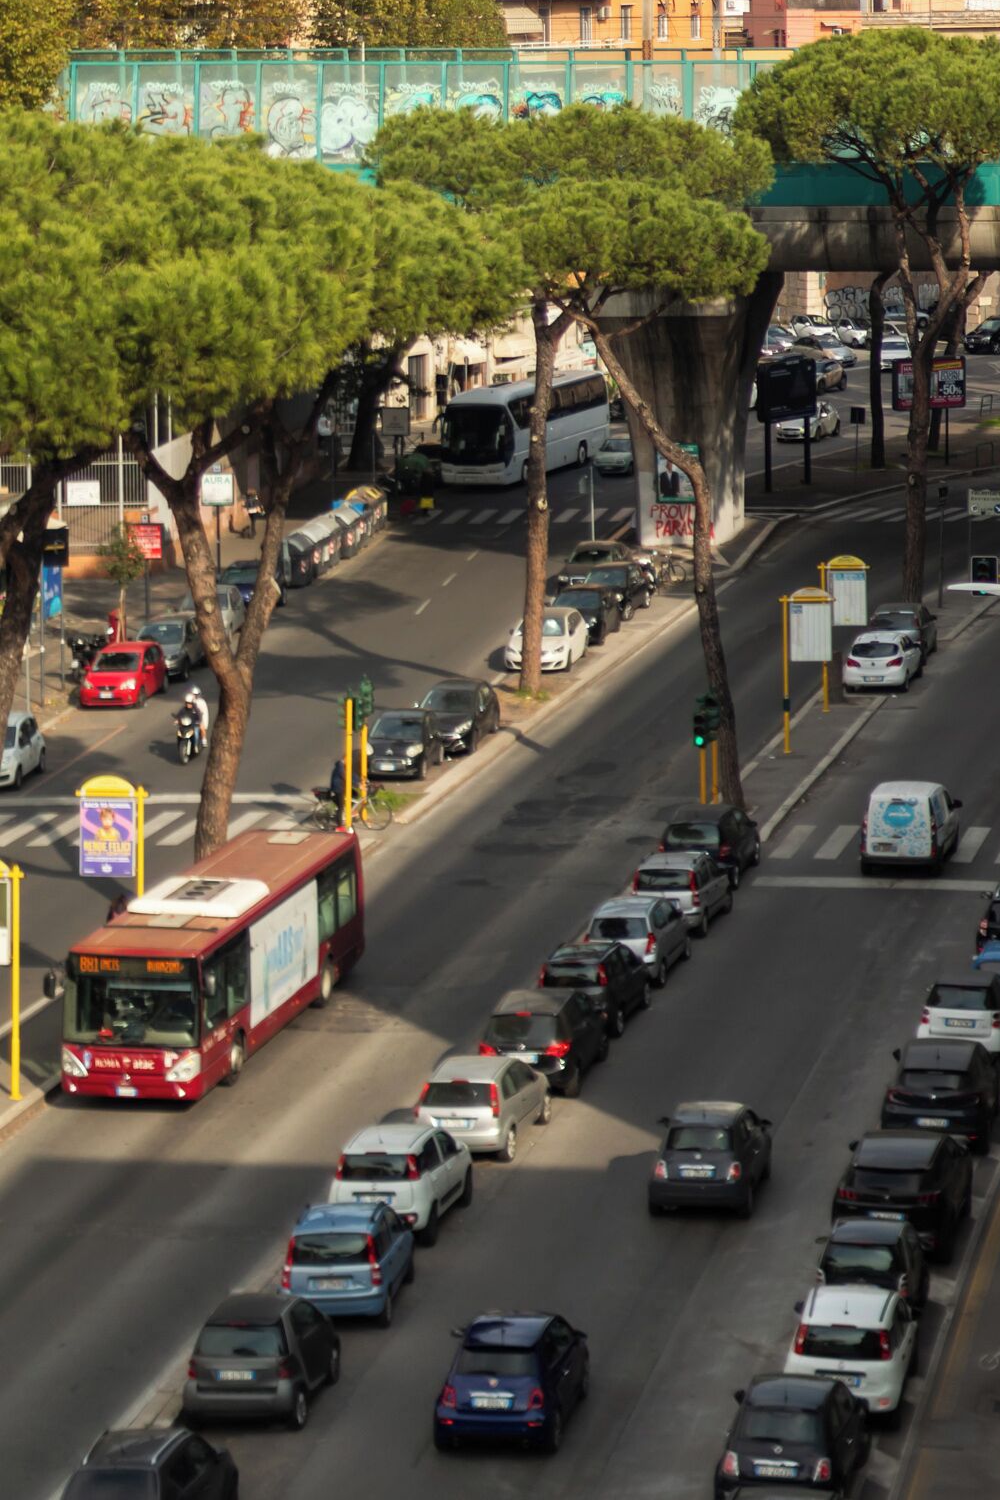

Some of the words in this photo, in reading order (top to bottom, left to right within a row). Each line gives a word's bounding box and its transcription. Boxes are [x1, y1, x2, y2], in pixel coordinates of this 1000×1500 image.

[940, 384, 962, 395] -50%
[204, 476, 231, 485] AURA
[79, 956, 99, 973] 881
[94, 1057, 121, 1069] ROMA
